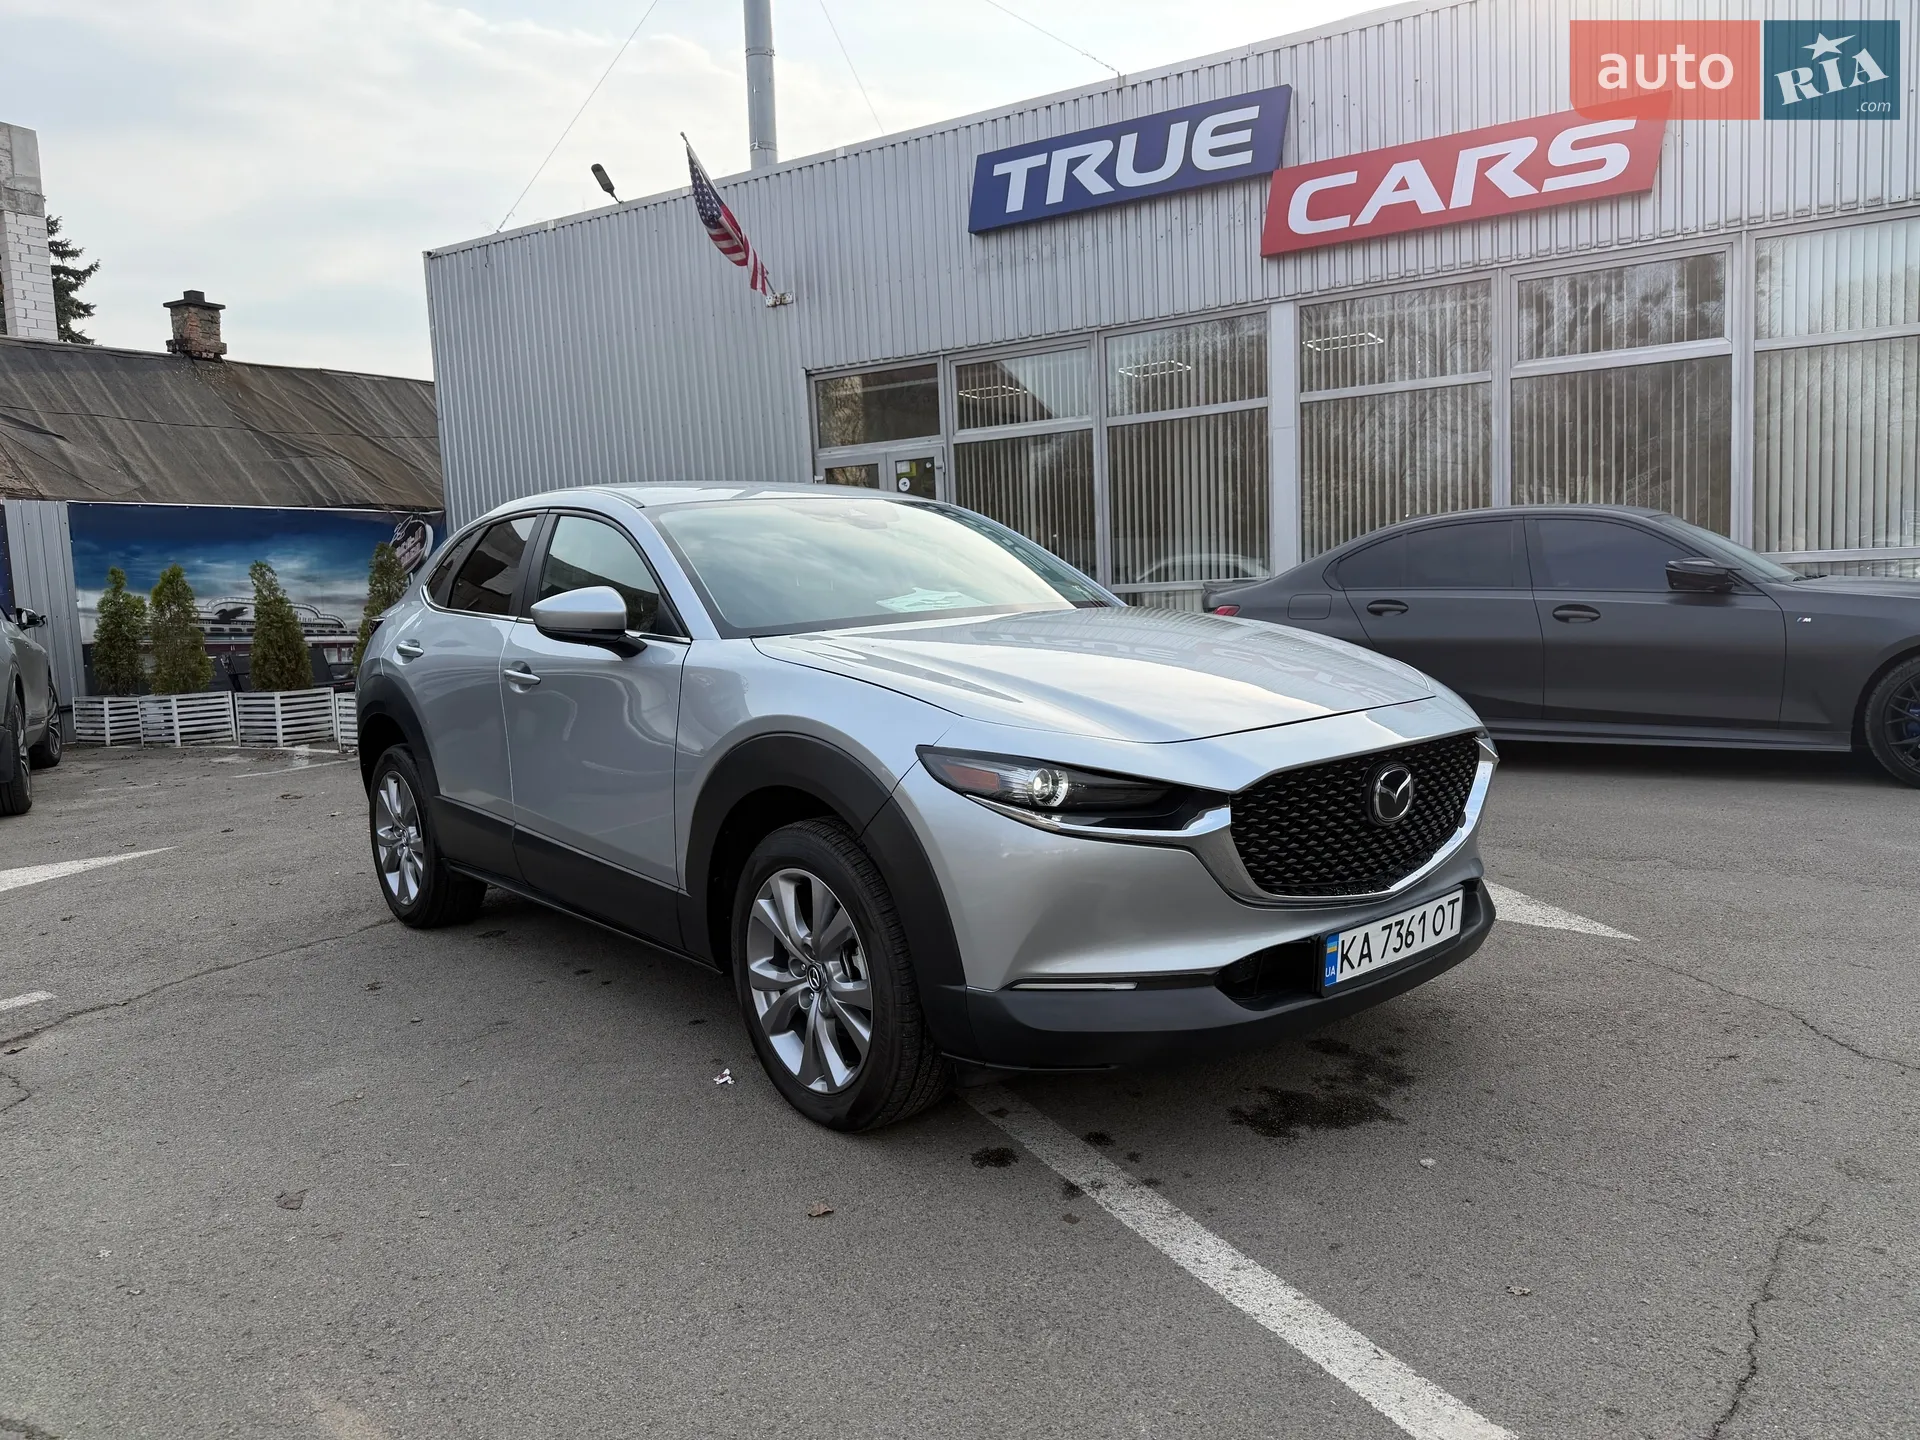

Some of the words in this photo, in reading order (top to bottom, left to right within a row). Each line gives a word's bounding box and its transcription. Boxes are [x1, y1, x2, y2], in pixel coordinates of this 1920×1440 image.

[992, 105, 1260, 214] TRUE
[1287, 115, 1638, 235] CARS
[1325, 966, 1336, 978] UA
[1340, 932, 1373, 974] KA
[1380, 910, 1427, 960] 7361
[1432, 897, 1460, 937] OT
